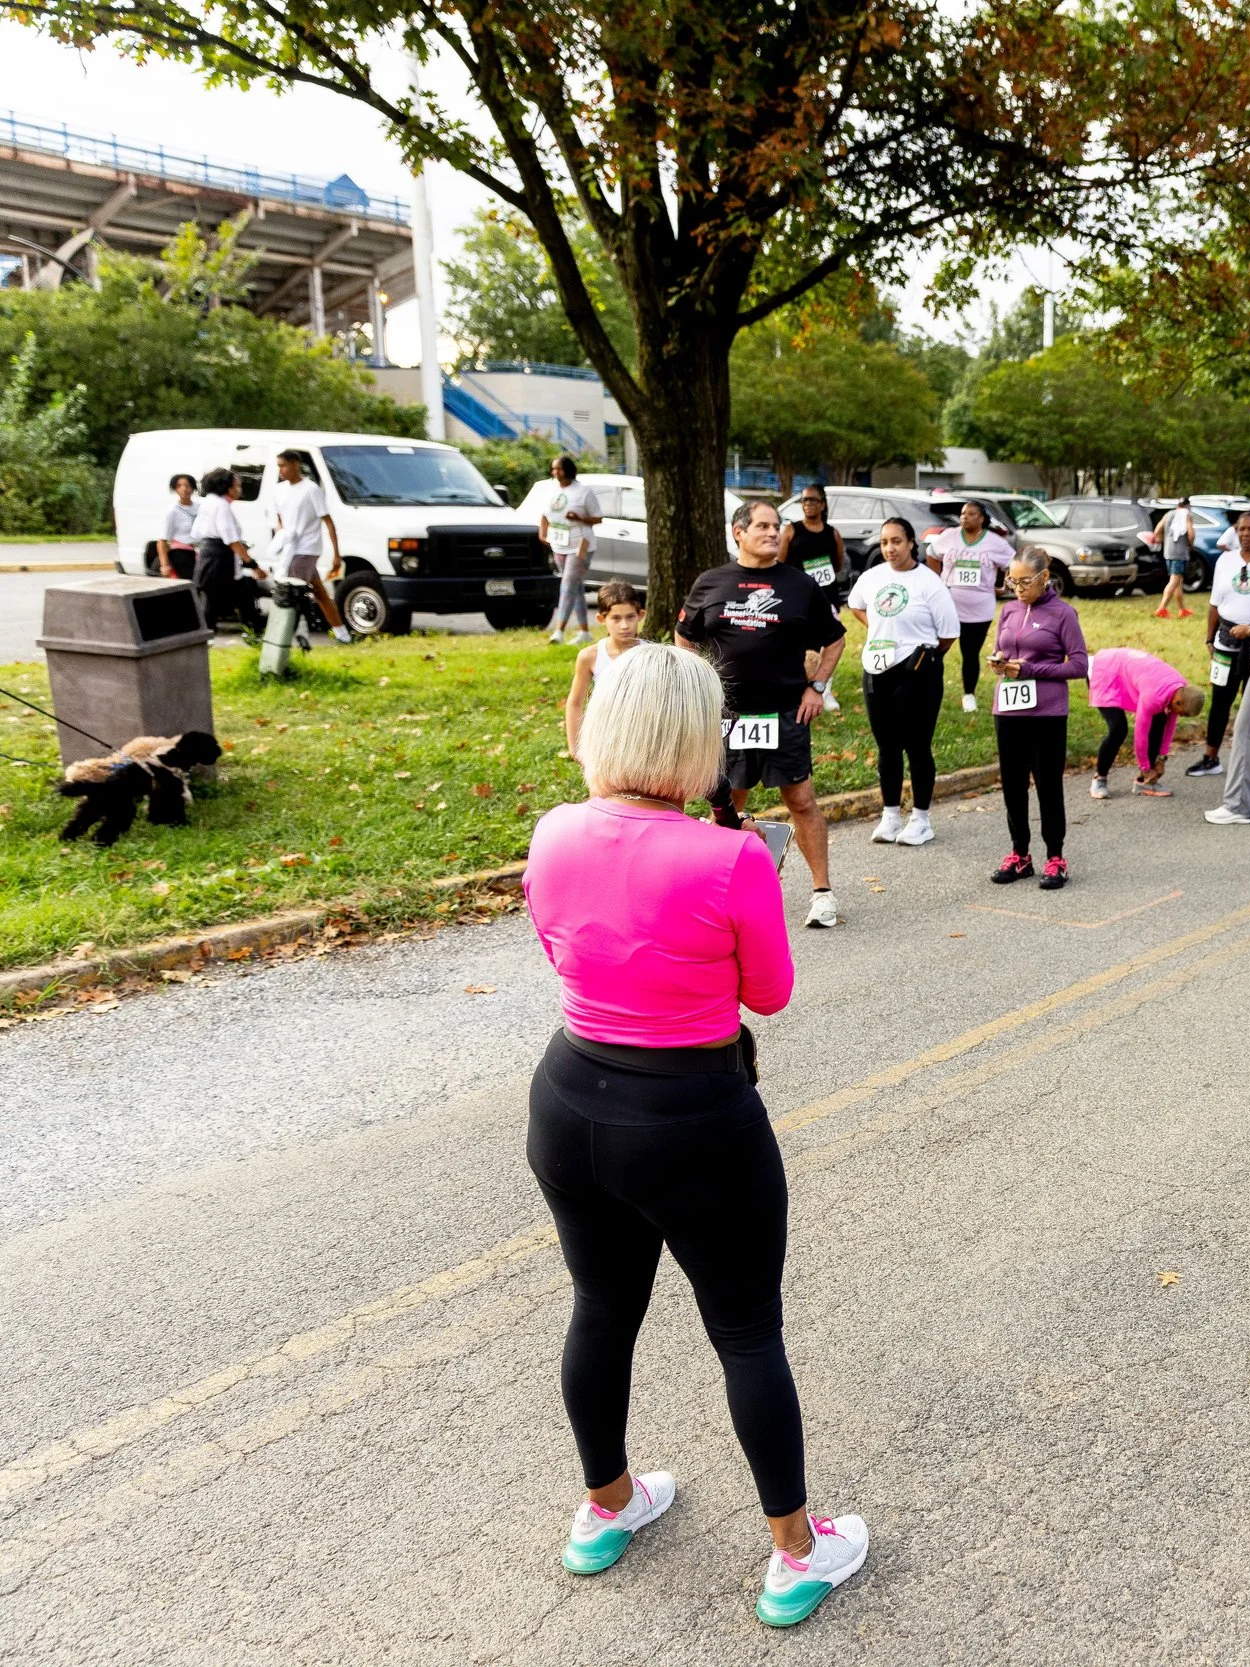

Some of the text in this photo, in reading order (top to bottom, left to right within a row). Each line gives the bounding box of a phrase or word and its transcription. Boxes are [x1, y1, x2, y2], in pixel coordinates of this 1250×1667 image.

[958, 571, 977, 583] 183
[723, 608, 746, 617] Tunnel
[755, 611, 779, 621] Towers
[730, 617, 767, 628] Foundation
[873, 653, 888, 671] 21
[1002, 684, 1031, 706] 179
[737, 723, 770, 744] 141
